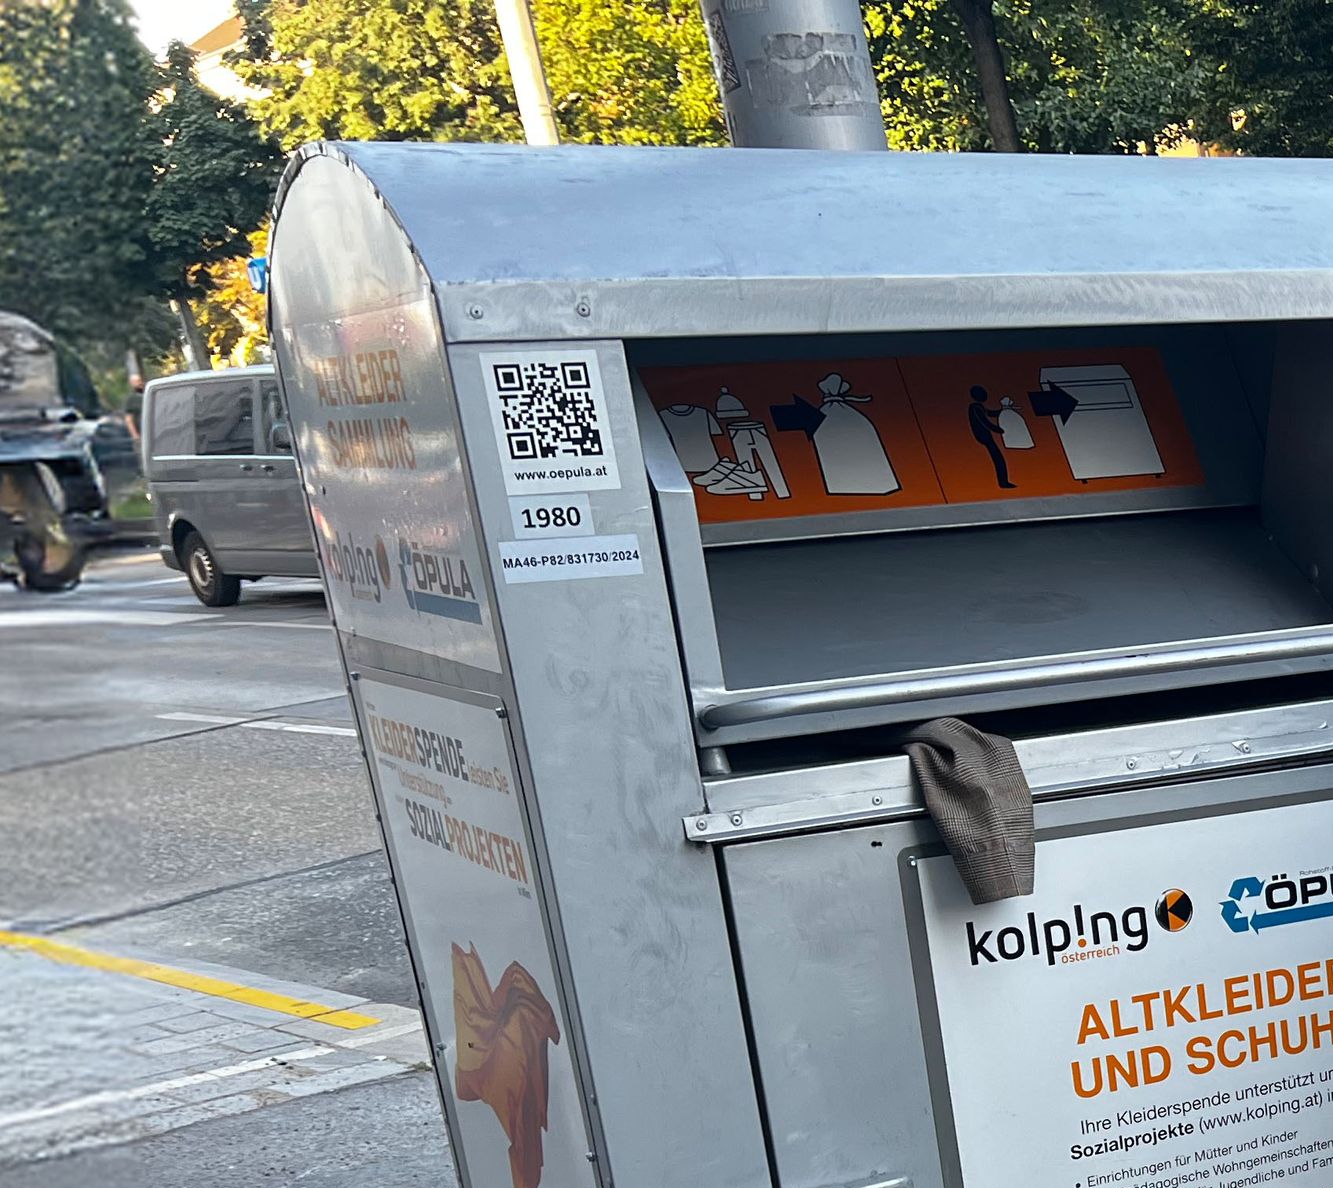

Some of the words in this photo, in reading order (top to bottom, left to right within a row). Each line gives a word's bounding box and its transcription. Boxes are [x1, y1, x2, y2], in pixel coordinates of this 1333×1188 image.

[327, 416, 417, 471] SAMMLUNG
[514, 465, 608, 481] www.oepula.at
[521, 506, 581, 529] 1980
[411, 541, 476, 600] ÖPULA
[502, 549, 640, 569] MA46-P82/831730/2024
[368, 713, 469, 782] KLEIDERSPENDE
[405, 798, 528, 885] SOZIALPROJEKTEN
[1060, 944, 1121, 965] österreich
[1070, 1043, 1173, 1099] UND
[1070, 1122, 1194, 1160] Sozialprojekte
[1198, 1090, 1323, 1135] (www.kolping.at)
[1080, 1118, 1112, 1135] Ihre
[1116, 1092, 1231, 1127] Kleiderspende
[1235, 1073, 1315, 1101] unterstützt
[1087, 1159, 1172, 1188] Einrichtungen
[1174, 1154, 1191, 1167] für
[1194, 1145, 1233, 1163] Mütter
[1236, 1138, 1258, 1153] und
[1261, 1130, 1298, 1147] Kinder
[1288, 1160, 1309, 1176] und
